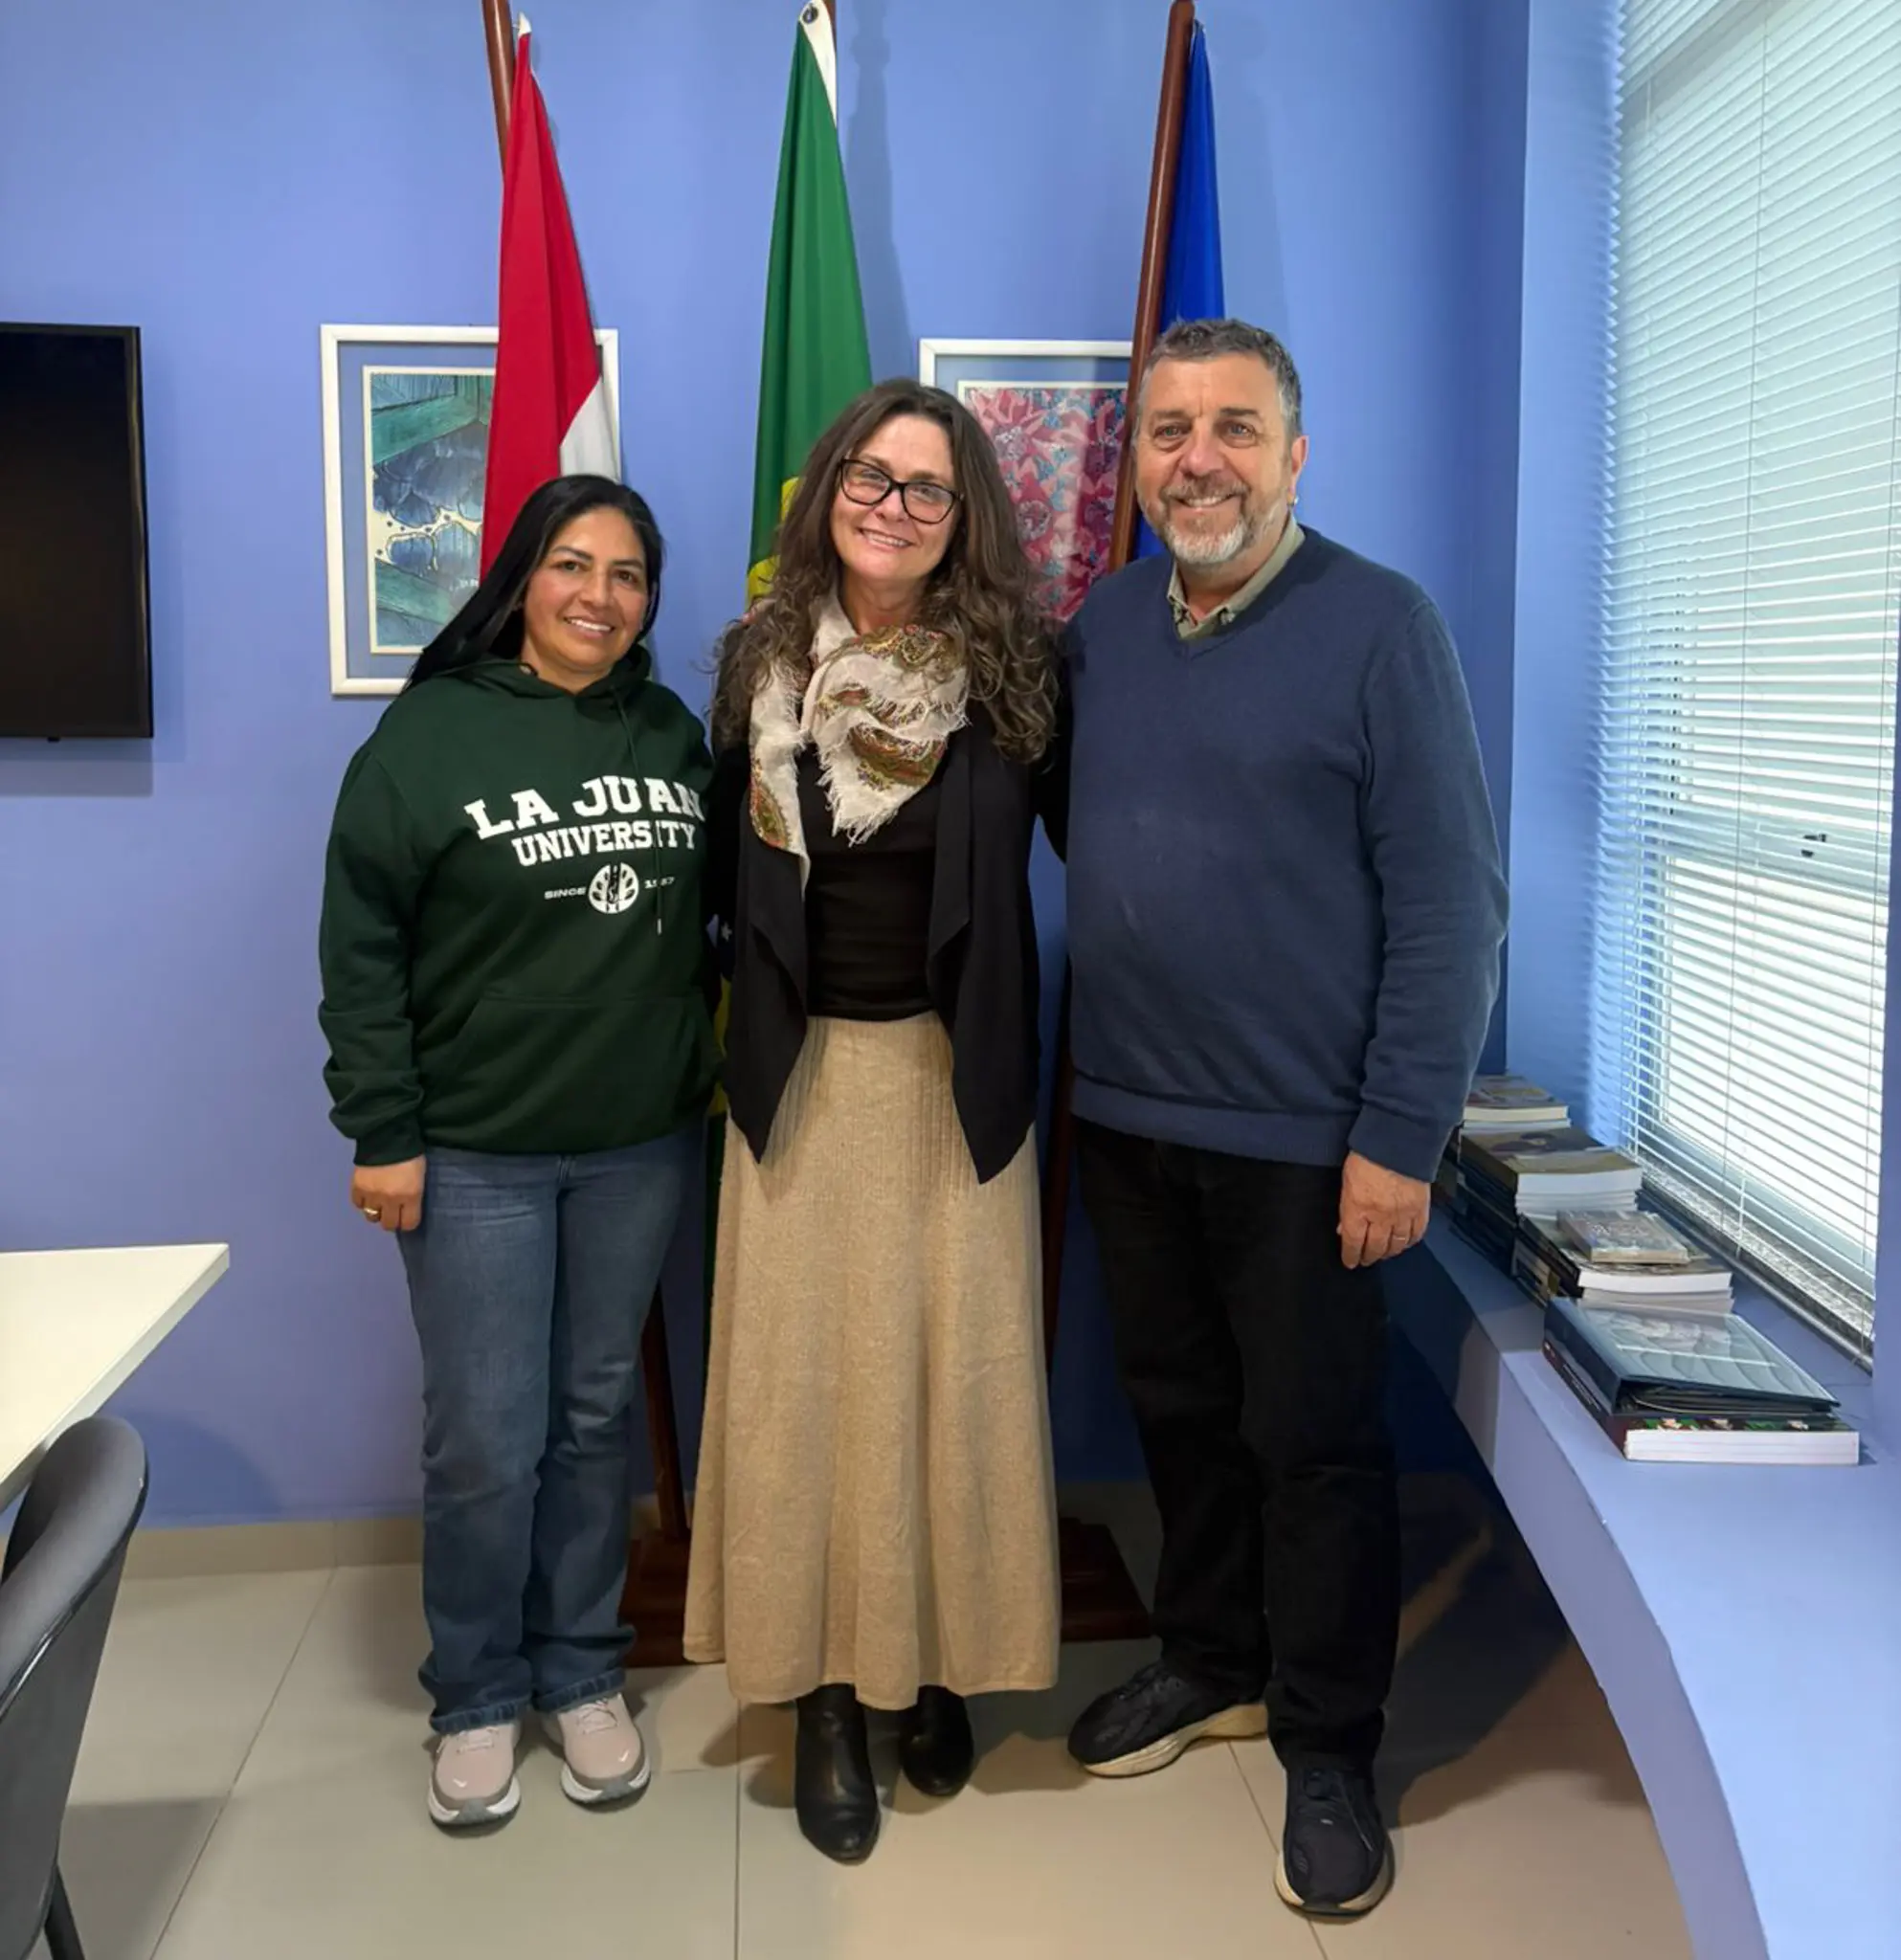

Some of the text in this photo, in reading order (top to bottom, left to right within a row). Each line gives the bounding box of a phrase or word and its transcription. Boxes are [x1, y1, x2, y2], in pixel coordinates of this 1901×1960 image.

[463, 775, 705, 840] LA JUAN
[545, 886, 587, 900] SINCE
